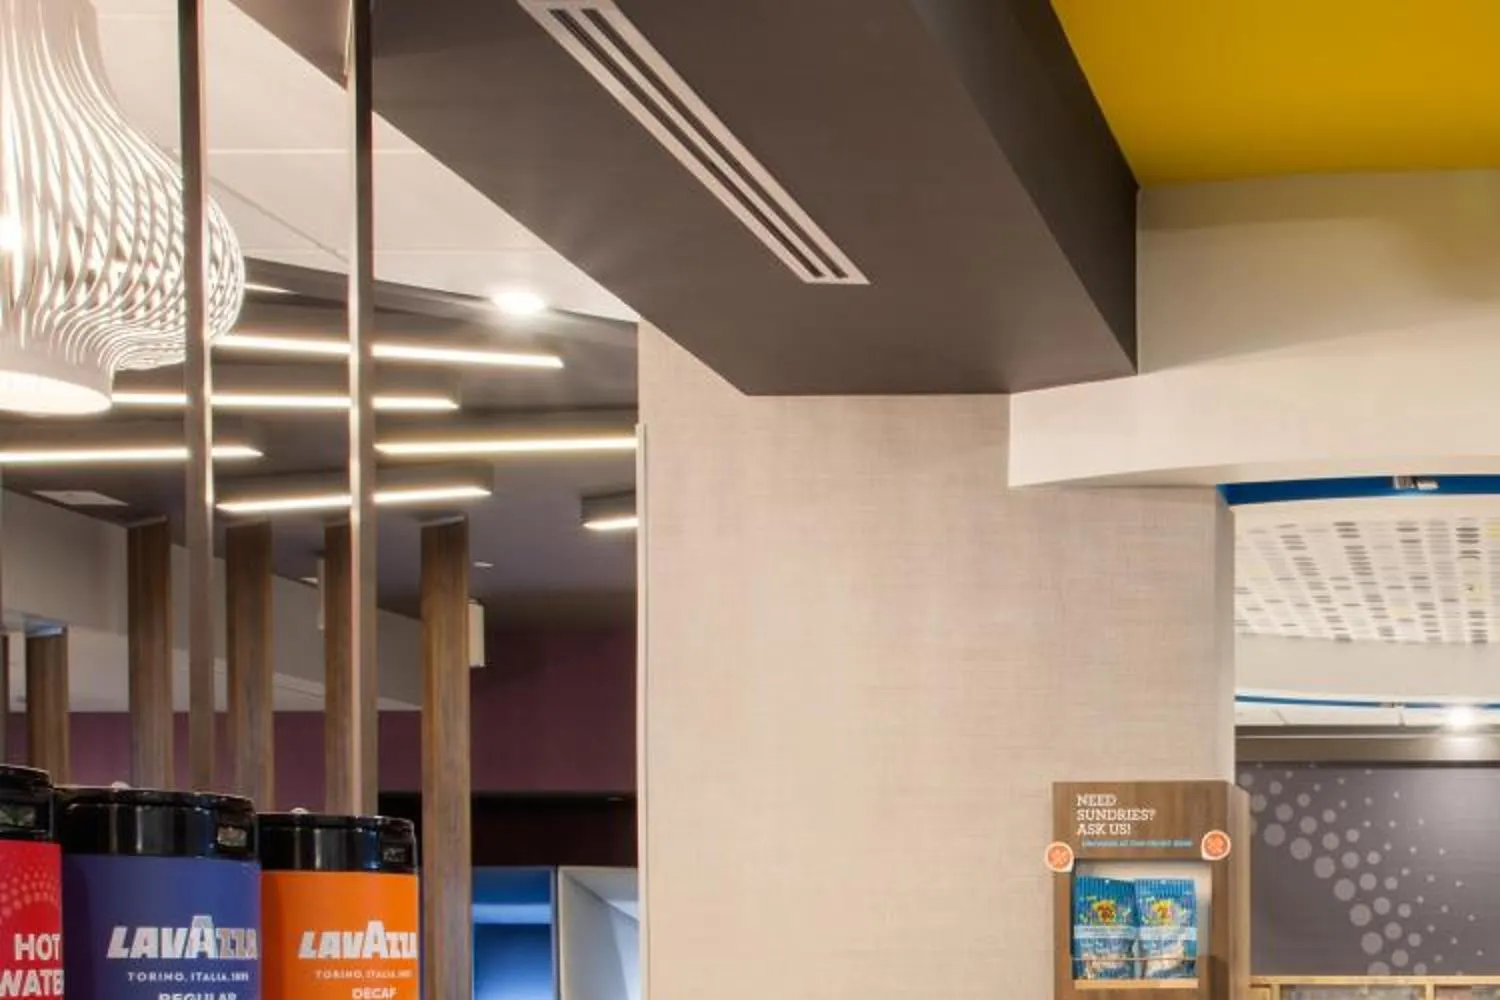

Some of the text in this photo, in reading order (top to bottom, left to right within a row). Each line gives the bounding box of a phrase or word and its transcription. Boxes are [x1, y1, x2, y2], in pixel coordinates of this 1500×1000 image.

[1076, 794, 1118, 806] NEED
[1076, 809, 1157, 821] SUNDRIES?
[1076, 823, 1132, 835] ASK US!
[14, 933, 61, 961] HOT
[352, 987, 397, 1000] DECAF
